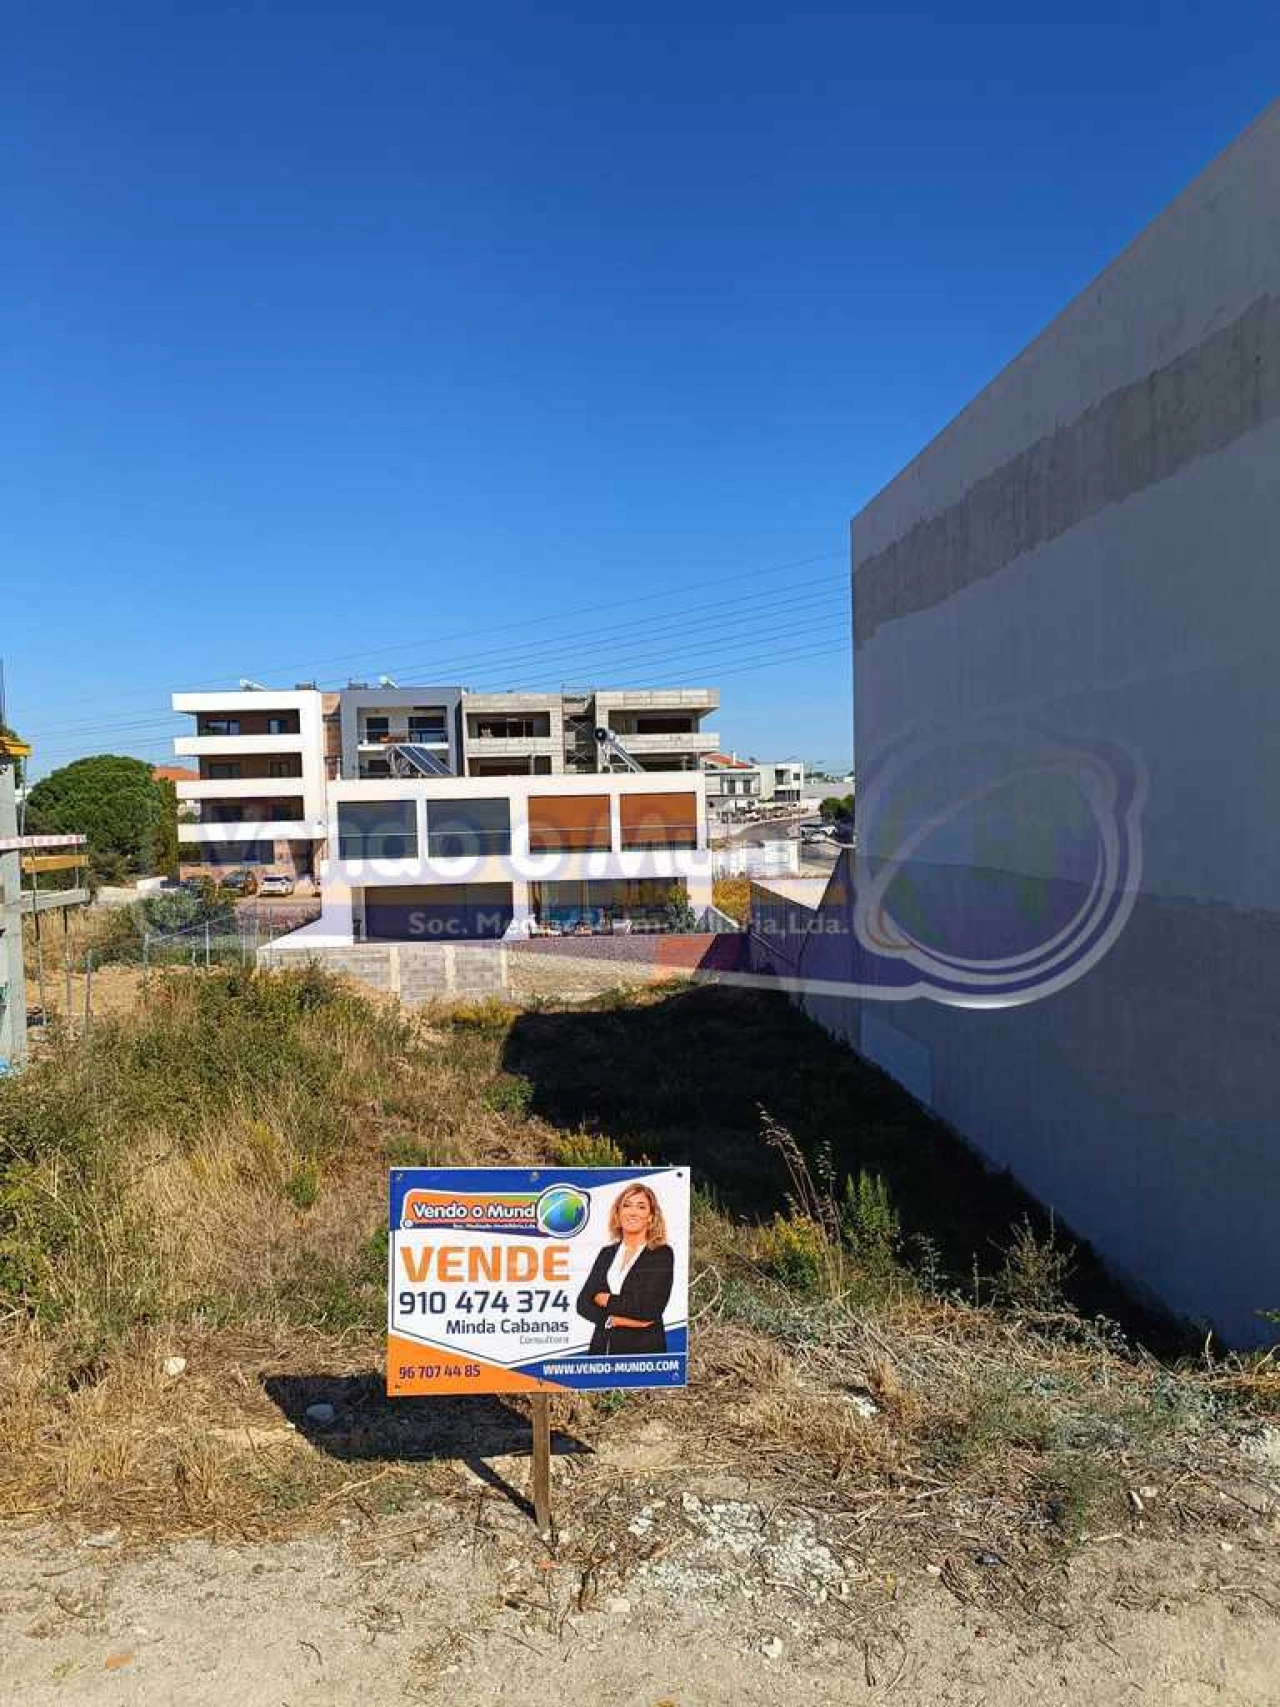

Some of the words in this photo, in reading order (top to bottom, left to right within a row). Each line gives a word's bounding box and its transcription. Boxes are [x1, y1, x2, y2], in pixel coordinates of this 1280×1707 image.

[413, 1200, 467, 1219] Vendo
[472, 1205, 484, 1218] o
[400, 1244, 571, 1283] VENDE
[399, 1291, 446, 1315] 910
[455, 1291, 509, 1315] 474
[516, 1291, 571, 1314] 374
[447, 1319, 496, 1335] Minda
[501, 1318, 569, 1335] Cabanas
[399, 1366, 415, 1379] 96
[418, 1365, 441, 1378] 707
[444, 1364, 462, 1377] 44
[464, 1363, 481, 1378] 85
[542, 1359, 679, 1376] WWW.VENDO-MUNDO.COM
